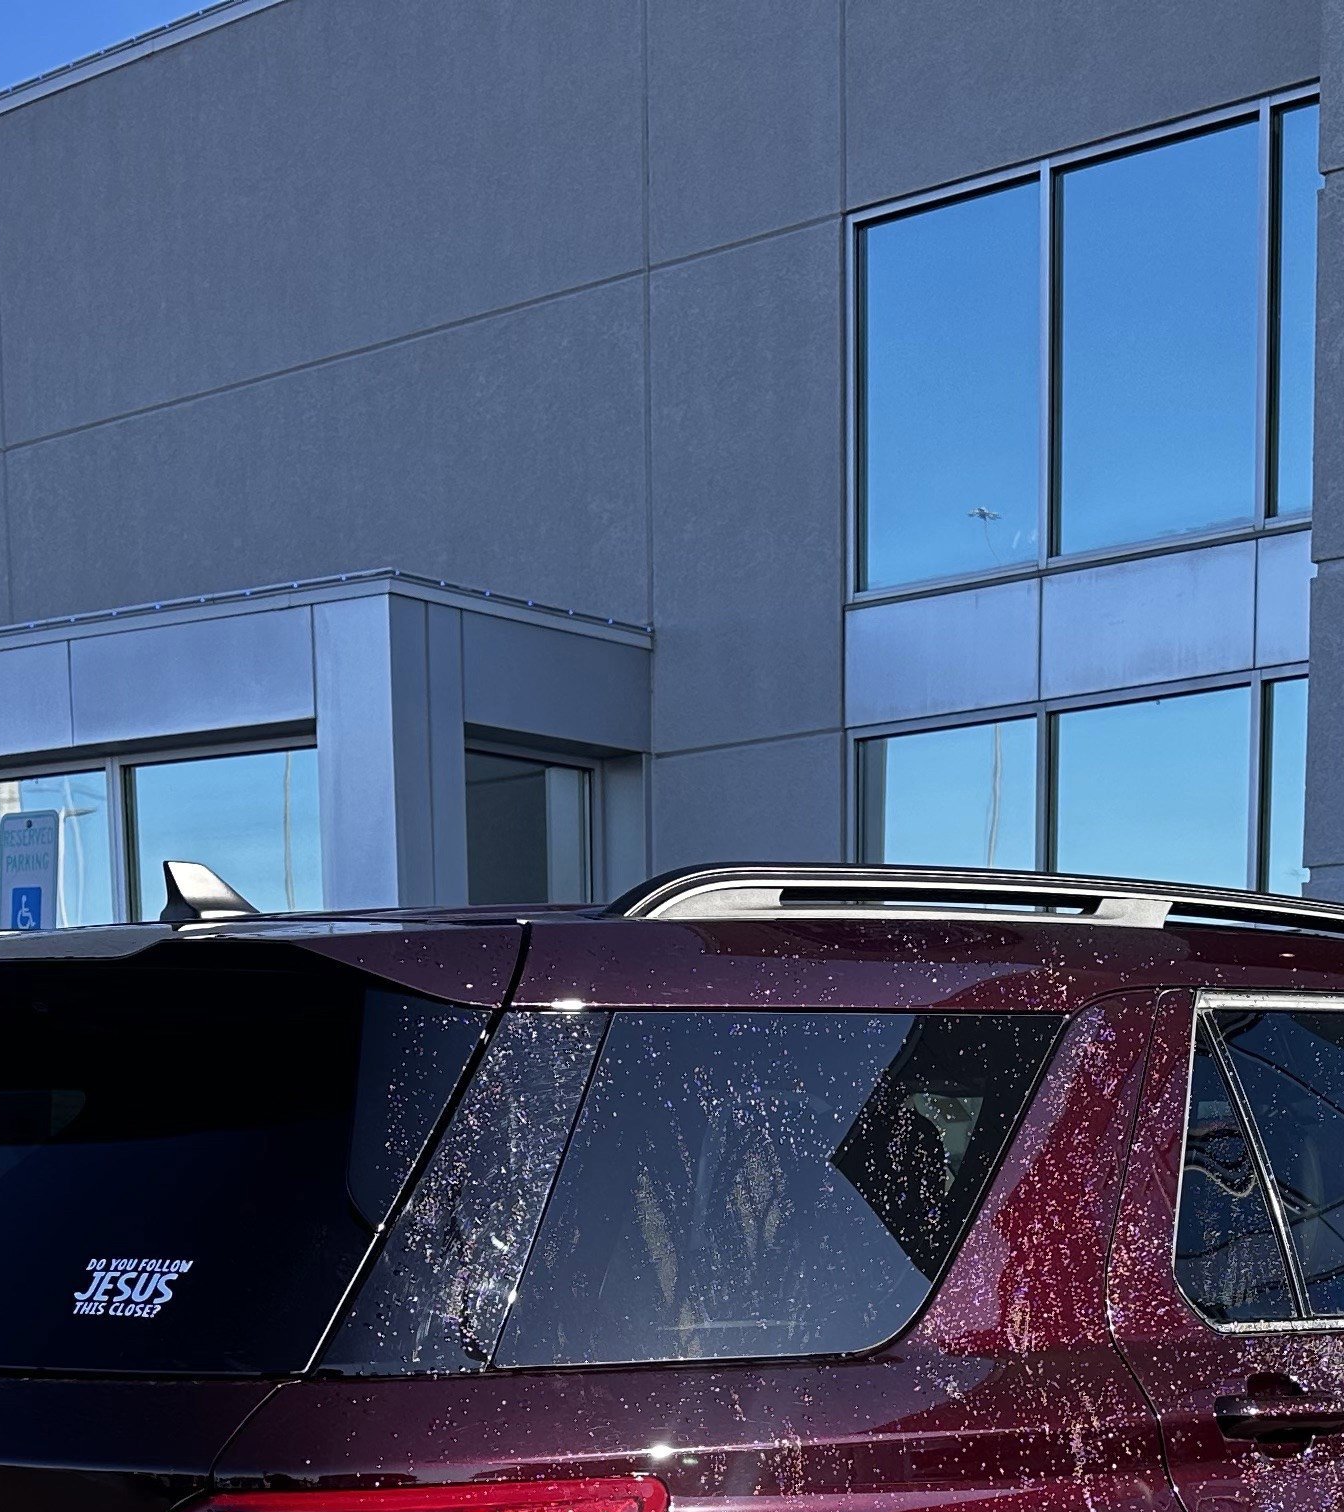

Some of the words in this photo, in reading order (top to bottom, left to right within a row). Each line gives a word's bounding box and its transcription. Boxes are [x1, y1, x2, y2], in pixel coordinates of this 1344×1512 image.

[2, 827, 54, 848] RESERVED
[6, 852, 50, 873] PARKING
[86, 1259, 107, 1271] DO
[110, 1259, 138, 1271] YOU
[138, 1259, 194, 1273] FOLLOW
[73, 1271, 178, 1304] JESUS
[73, 1302, 107, 1315] THIS
[108, 1303, 161, 1318] CLOSE?
